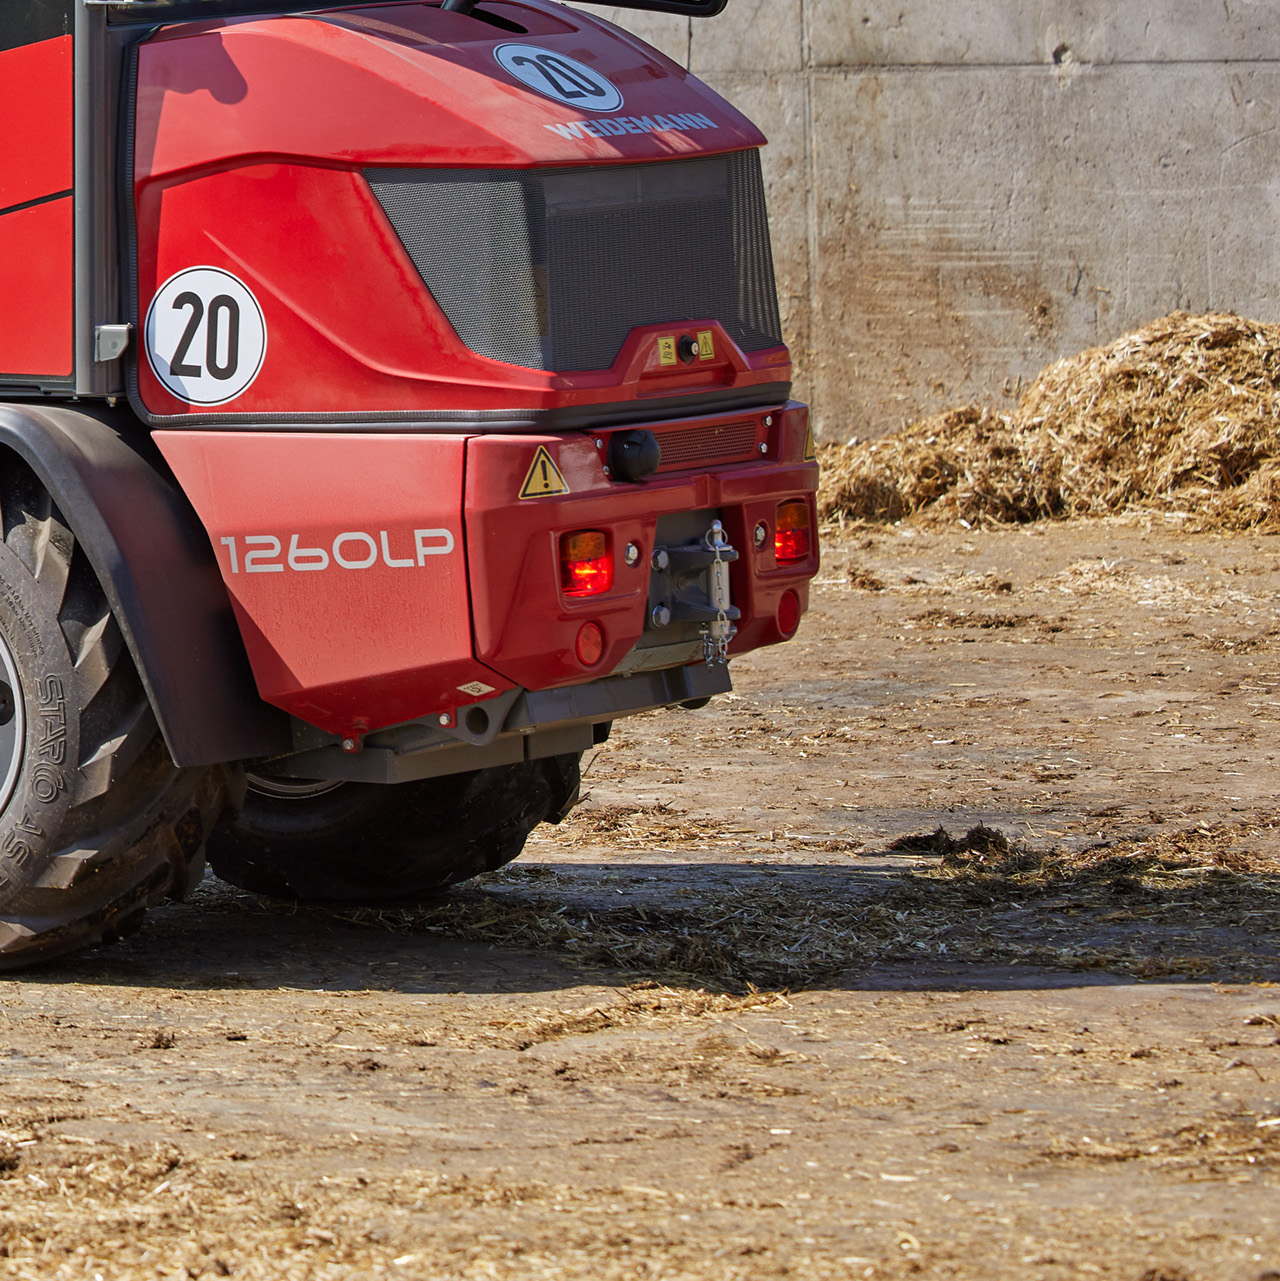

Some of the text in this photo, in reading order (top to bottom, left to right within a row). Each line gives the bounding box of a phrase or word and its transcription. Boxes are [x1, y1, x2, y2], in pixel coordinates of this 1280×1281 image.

[512, 54, 606, 99] 20
[543, 111, 718, 141] WEIDEMANN
[170, 291, 241, 381] 20
[220, 528, 455, 574] 1260LP
